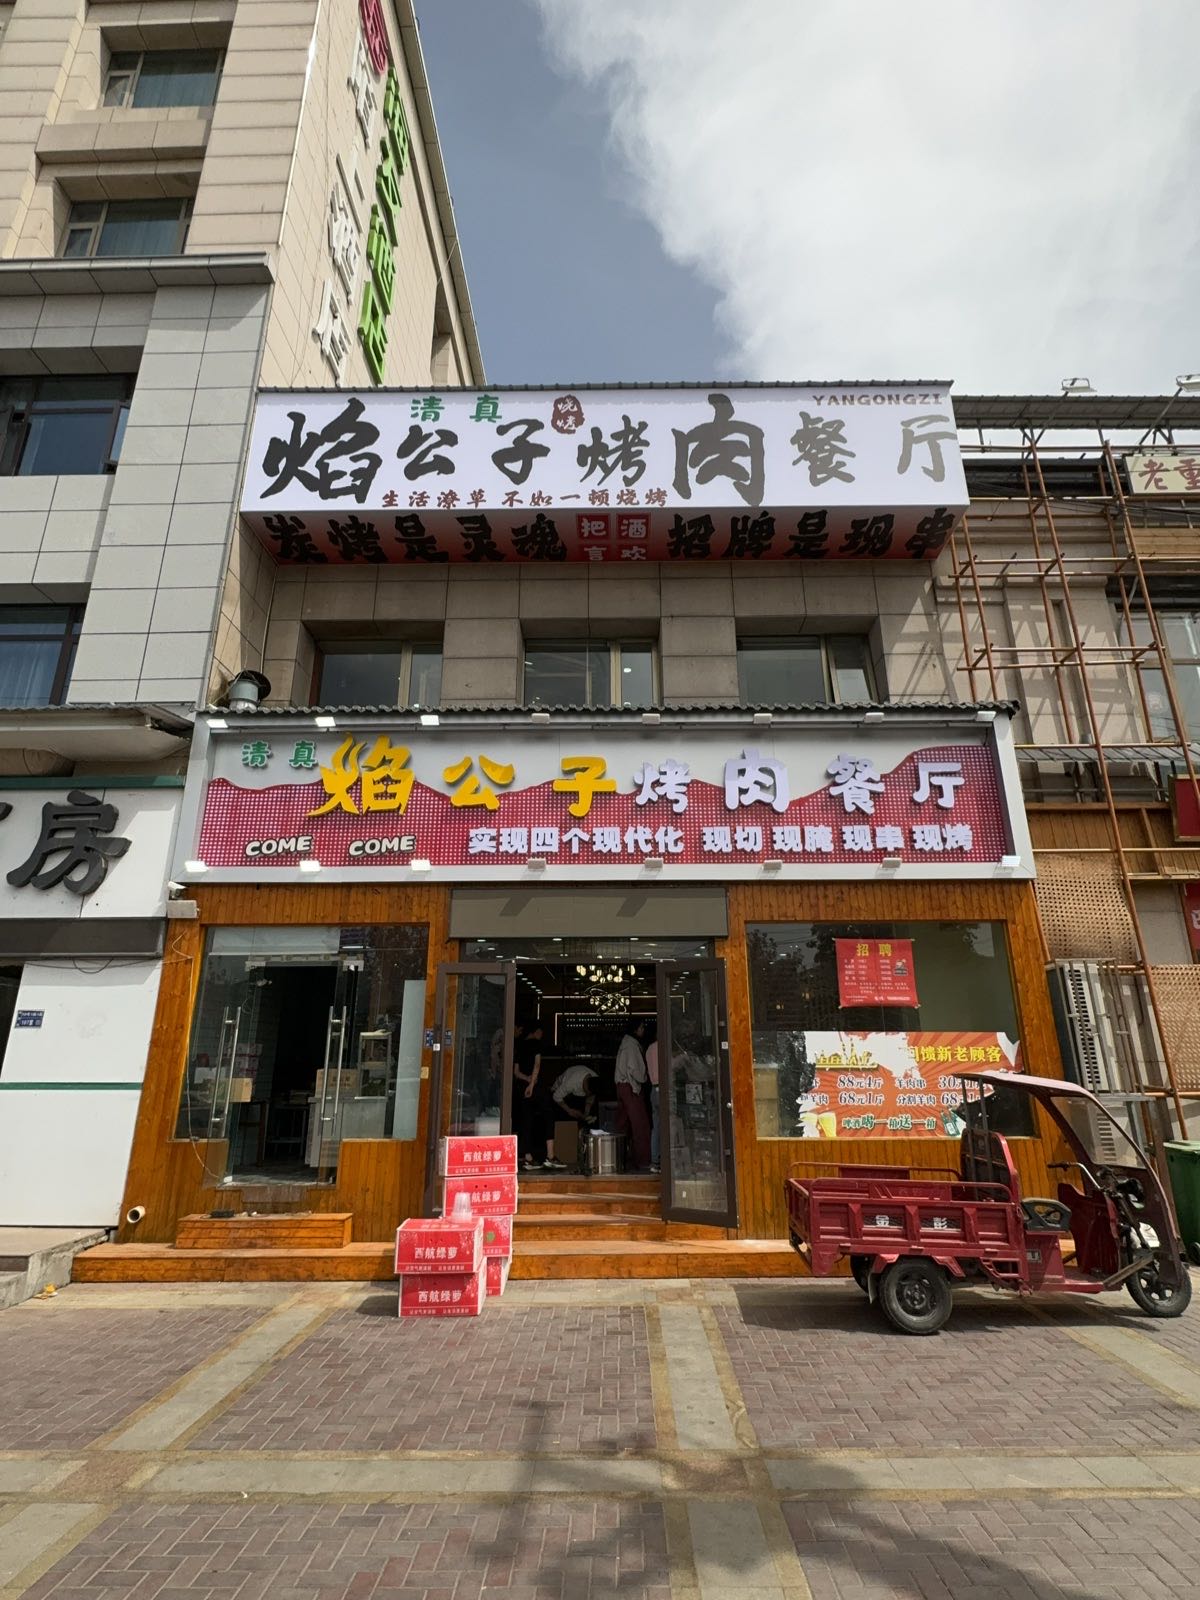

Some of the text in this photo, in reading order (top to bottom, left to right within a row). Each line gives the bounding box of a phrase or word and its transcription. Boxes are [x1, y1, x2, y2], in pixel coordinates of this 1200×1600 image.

[813, 393, 943, 406] YANGONGZI
[410, 394, 503, 423] 清真
[260, 393, 958, 507] 焰公子烤肉餐厅
[581, 518, 647, 538] 把酒
[667, 507, 955, 560] 招牌是现串
[241, 739, 318, 769] 清真
[0, 790, 132, 896] 房
[245, 835, 417, 858] COME COME
[469, 824, 973, 854] 实现四个现代化 现切 现腌 现串 现烤
[856, 943, 892, 957] 招聘
[838, 1075, 884, 1089] 88元4斤
[839, 1091, 885, 1105] 68元1斤
[463, 1150, 502, 1162] 西航绿萝
[468, 1191, 502, 1203] 航绿萝
[414, 1246, 458, 1260] 西航绿萝
[418, 1289, 462, 1303] 西航绿萝
